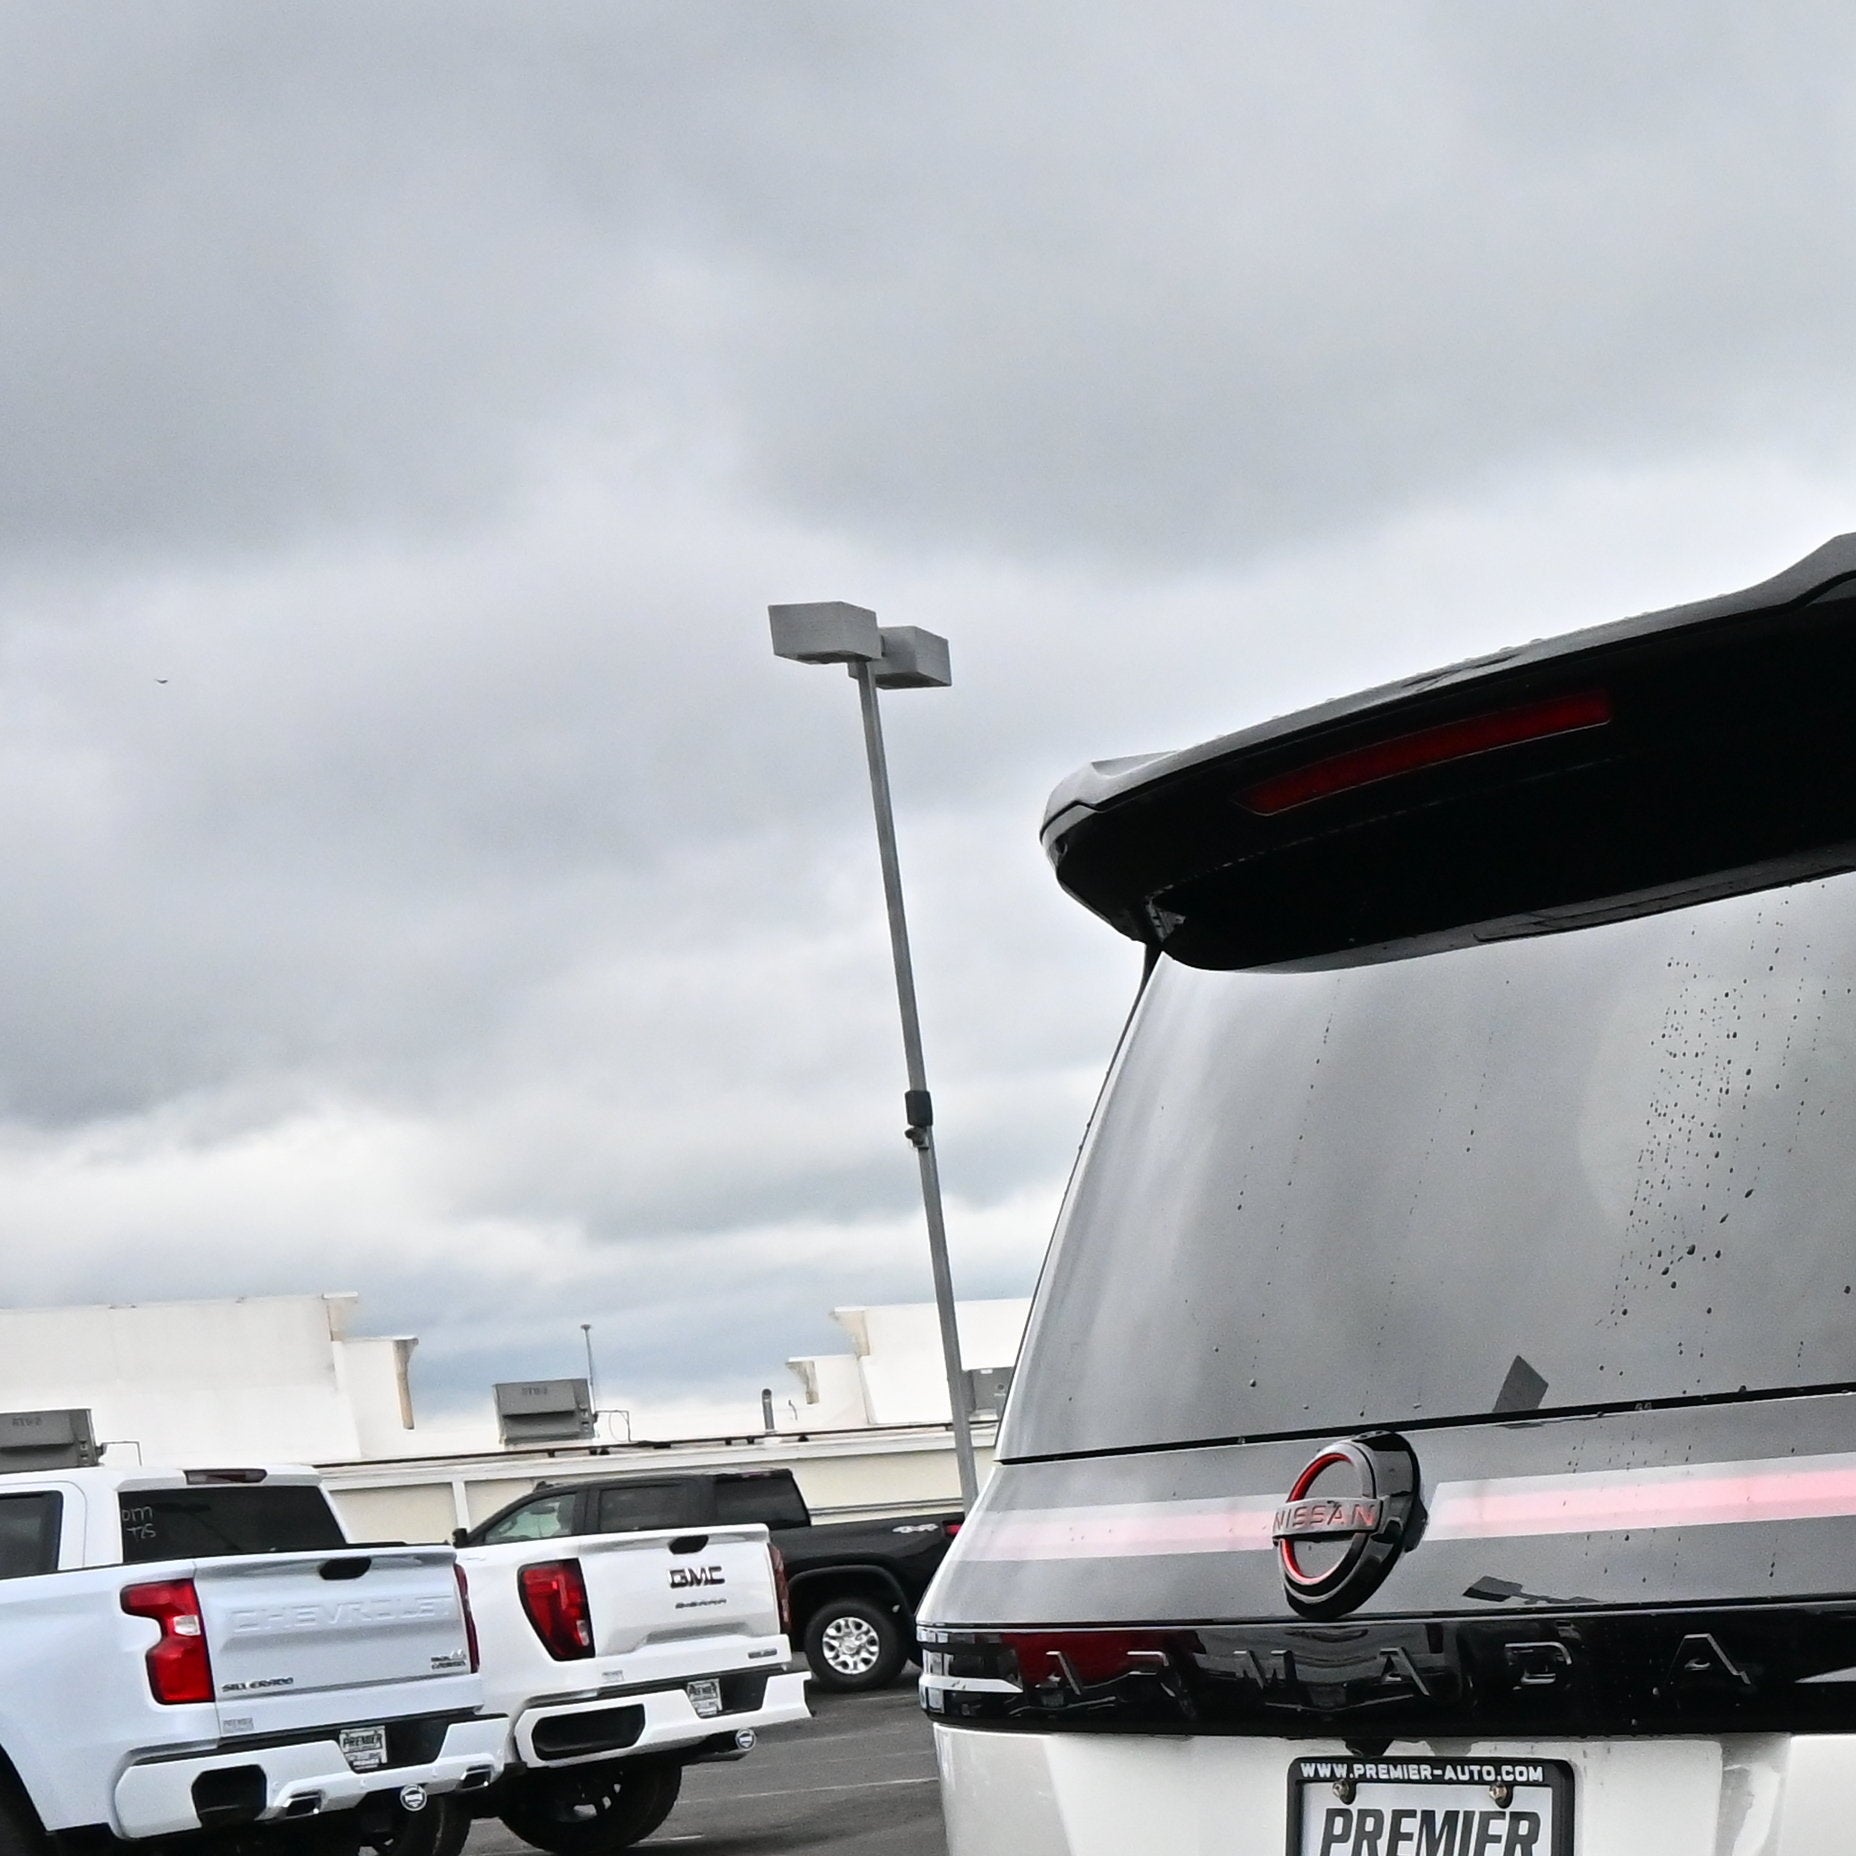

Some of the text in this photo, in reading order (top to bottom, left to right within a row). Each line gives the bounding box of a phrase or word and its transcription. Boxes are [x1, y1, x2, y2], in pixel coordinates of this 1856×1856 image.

[1273, 1503, 1377, 1532] NISSAN
[670, 1566, 726, 1589] GMC
[1300, 1763, 1543, 1782] WWW.PREMIER-AUTO.COM
